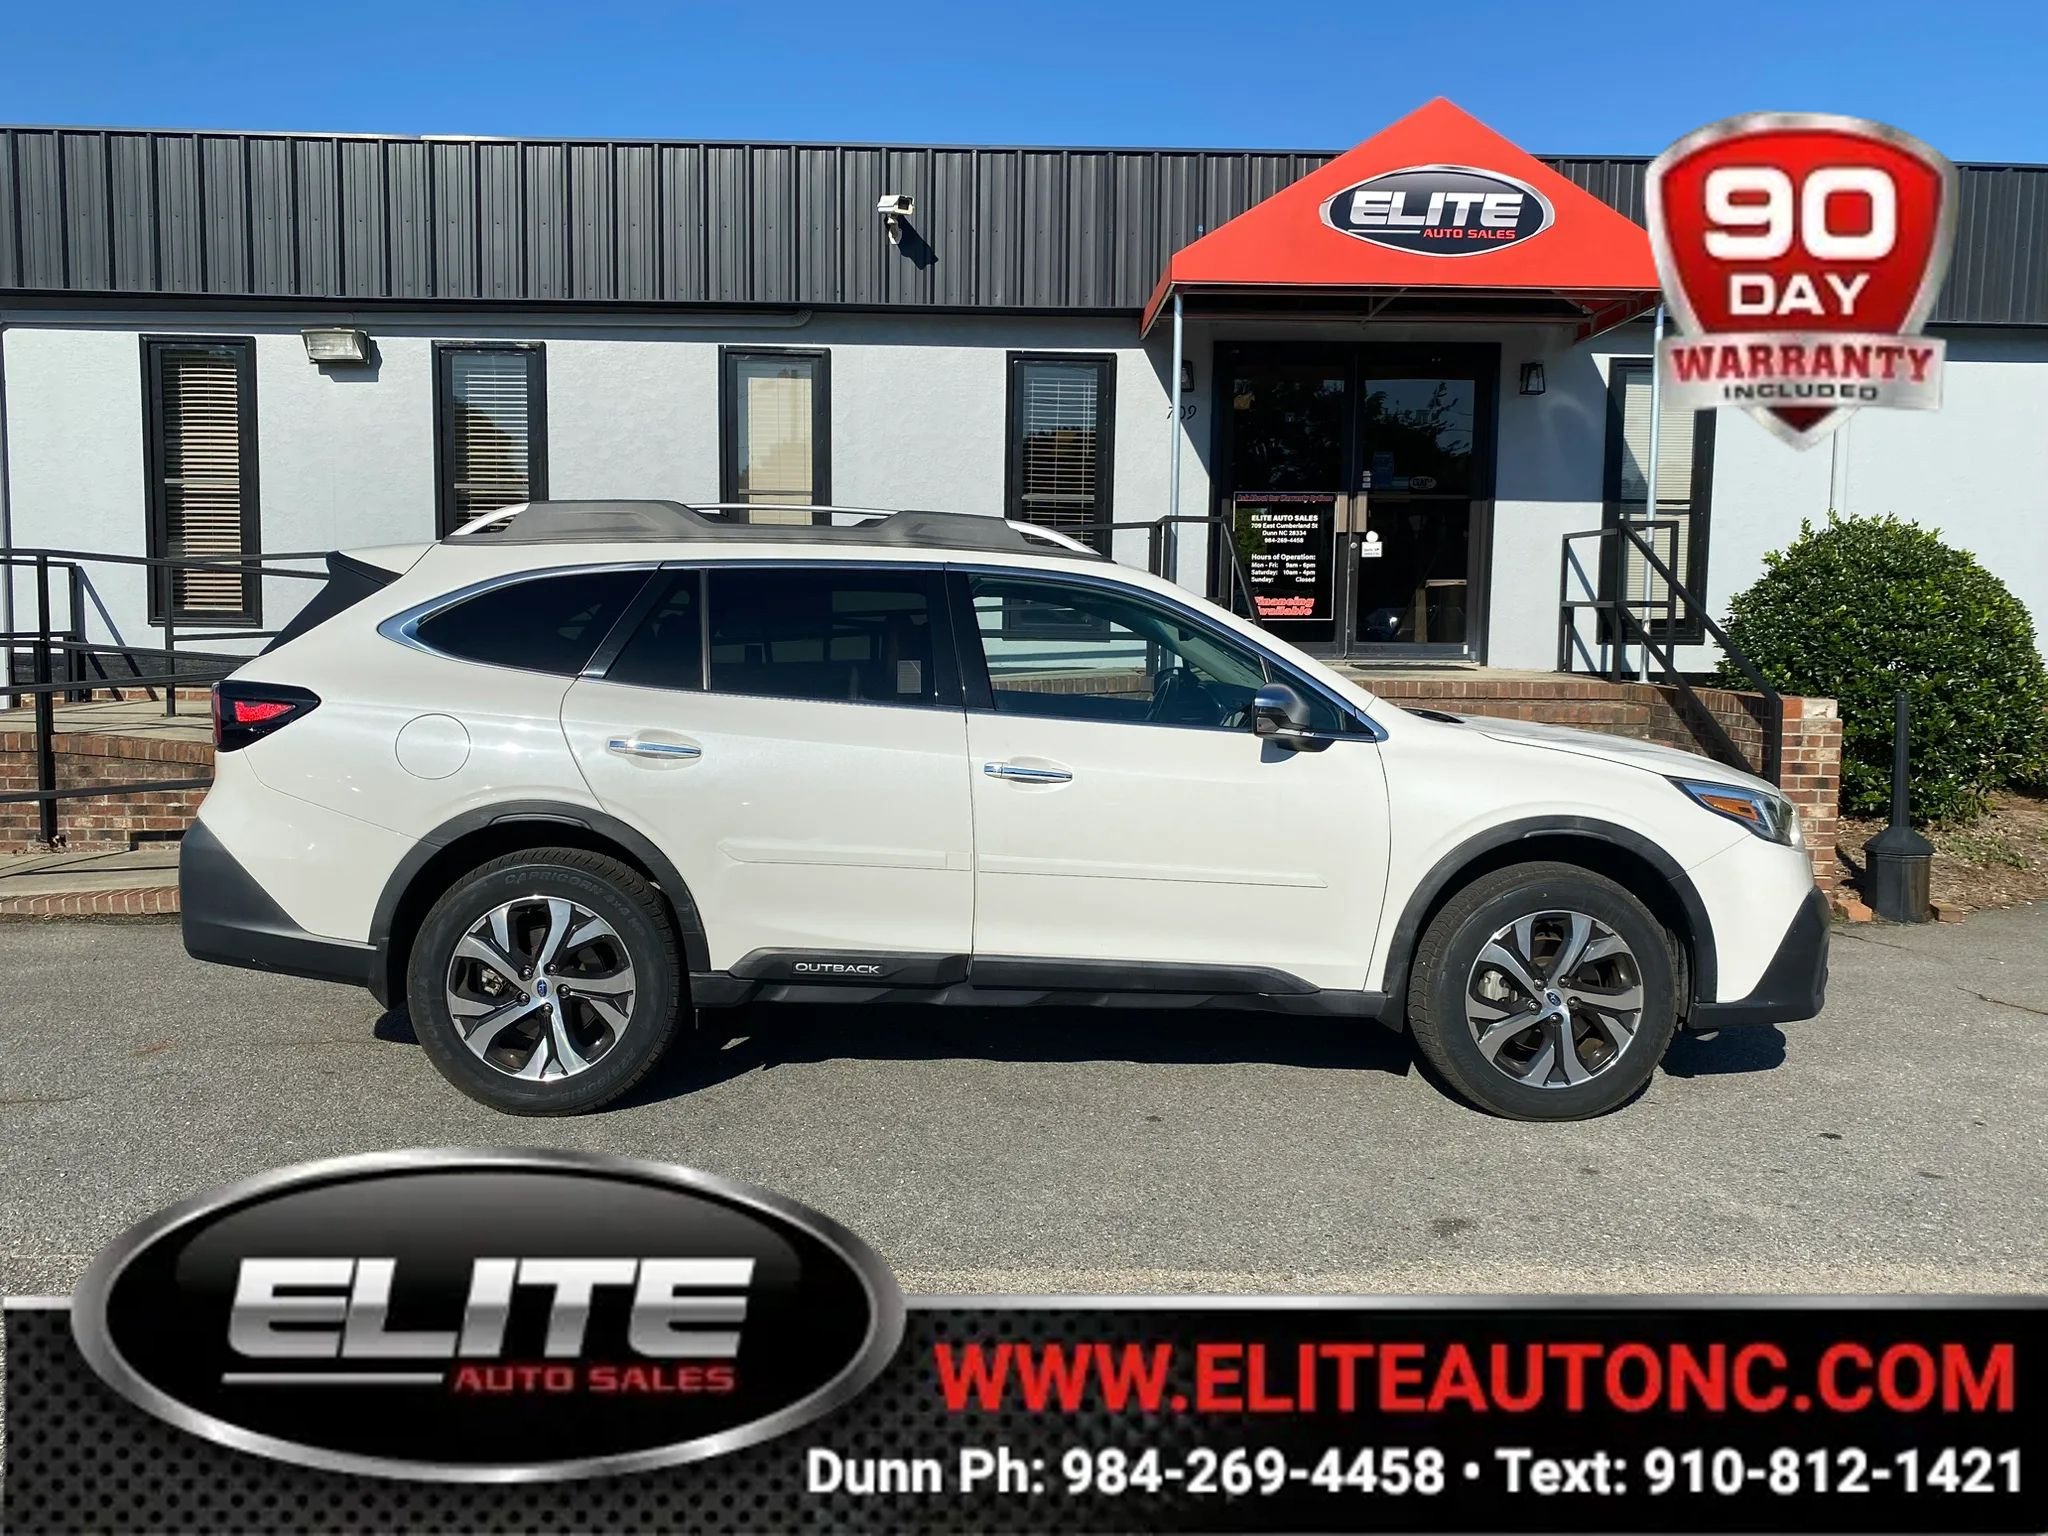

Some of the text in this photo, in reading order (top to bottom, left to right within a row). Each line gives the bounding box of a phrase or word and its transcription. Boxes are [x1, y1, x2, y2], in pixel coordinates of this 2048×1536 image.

[1350, 191, 1524, 227] ELITE
[1423, 228, 1516, 240] AUTO SALES
[1251, 514, 1319, 522] ELITE AUTO SALES
[1280, 553, 1316, 562] Operation:
[1257, 606, 1312, 616] vailable
[795, 962, 880, 974] OUTBACK
